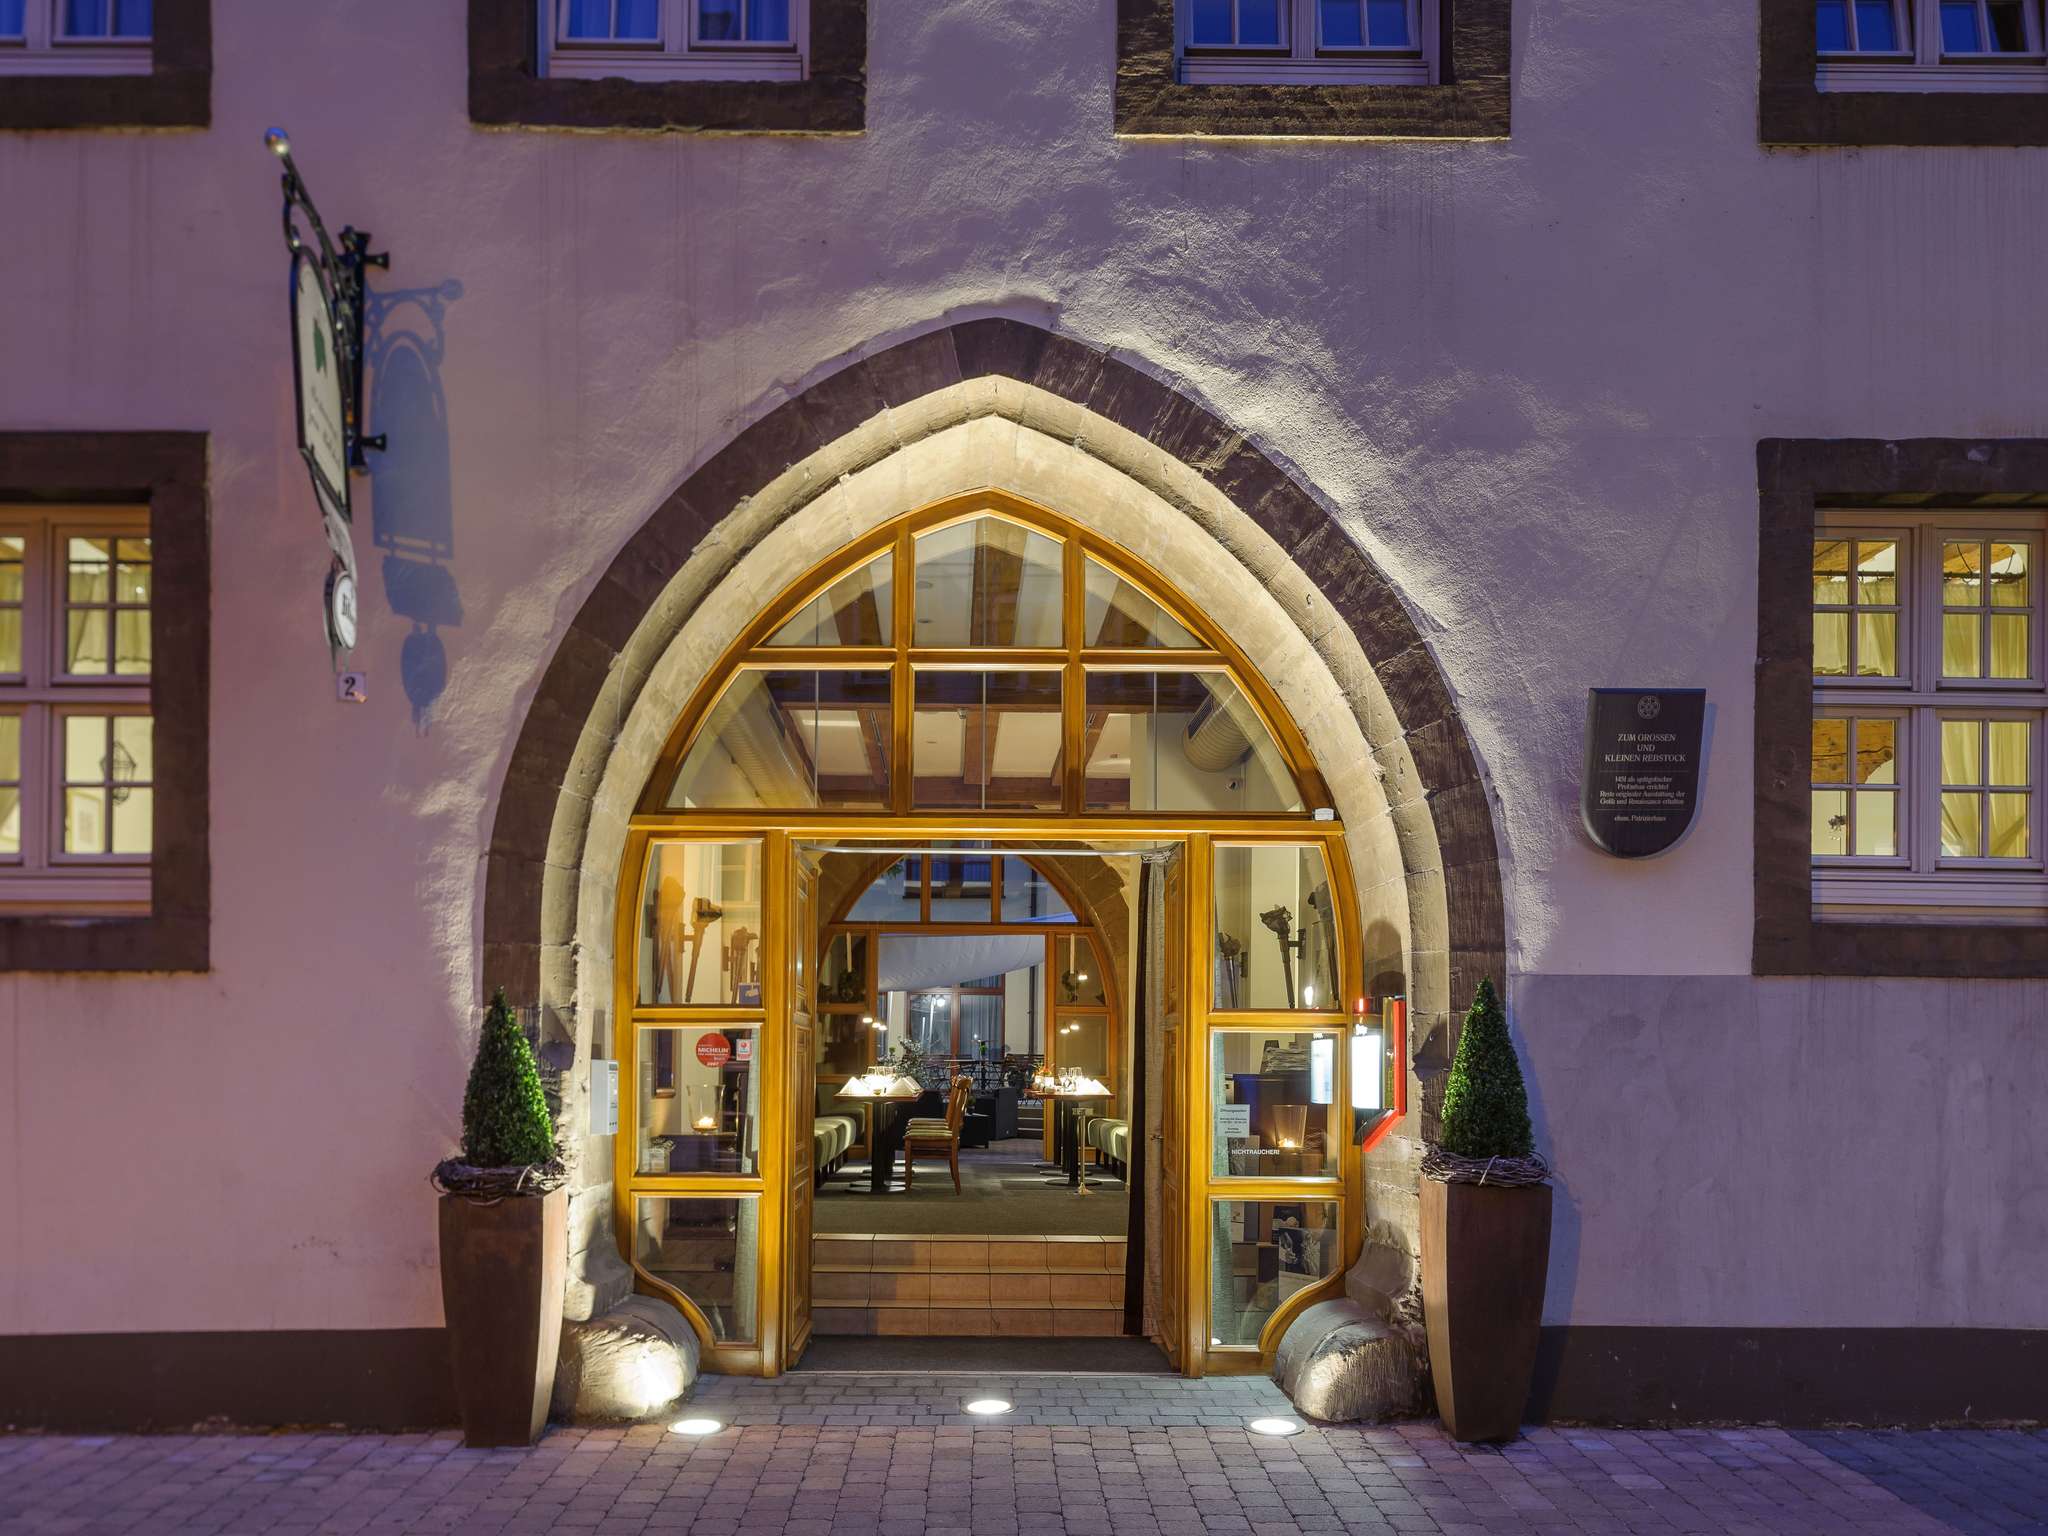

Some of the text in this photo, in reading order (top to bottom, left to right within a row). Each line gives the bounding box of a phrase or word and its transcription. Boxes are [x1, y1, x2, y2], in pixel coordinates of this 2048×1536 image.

[344, 676, 356, 696] 2
[1605, 754, 1686, 762] KLEINEN REBSTOCK
